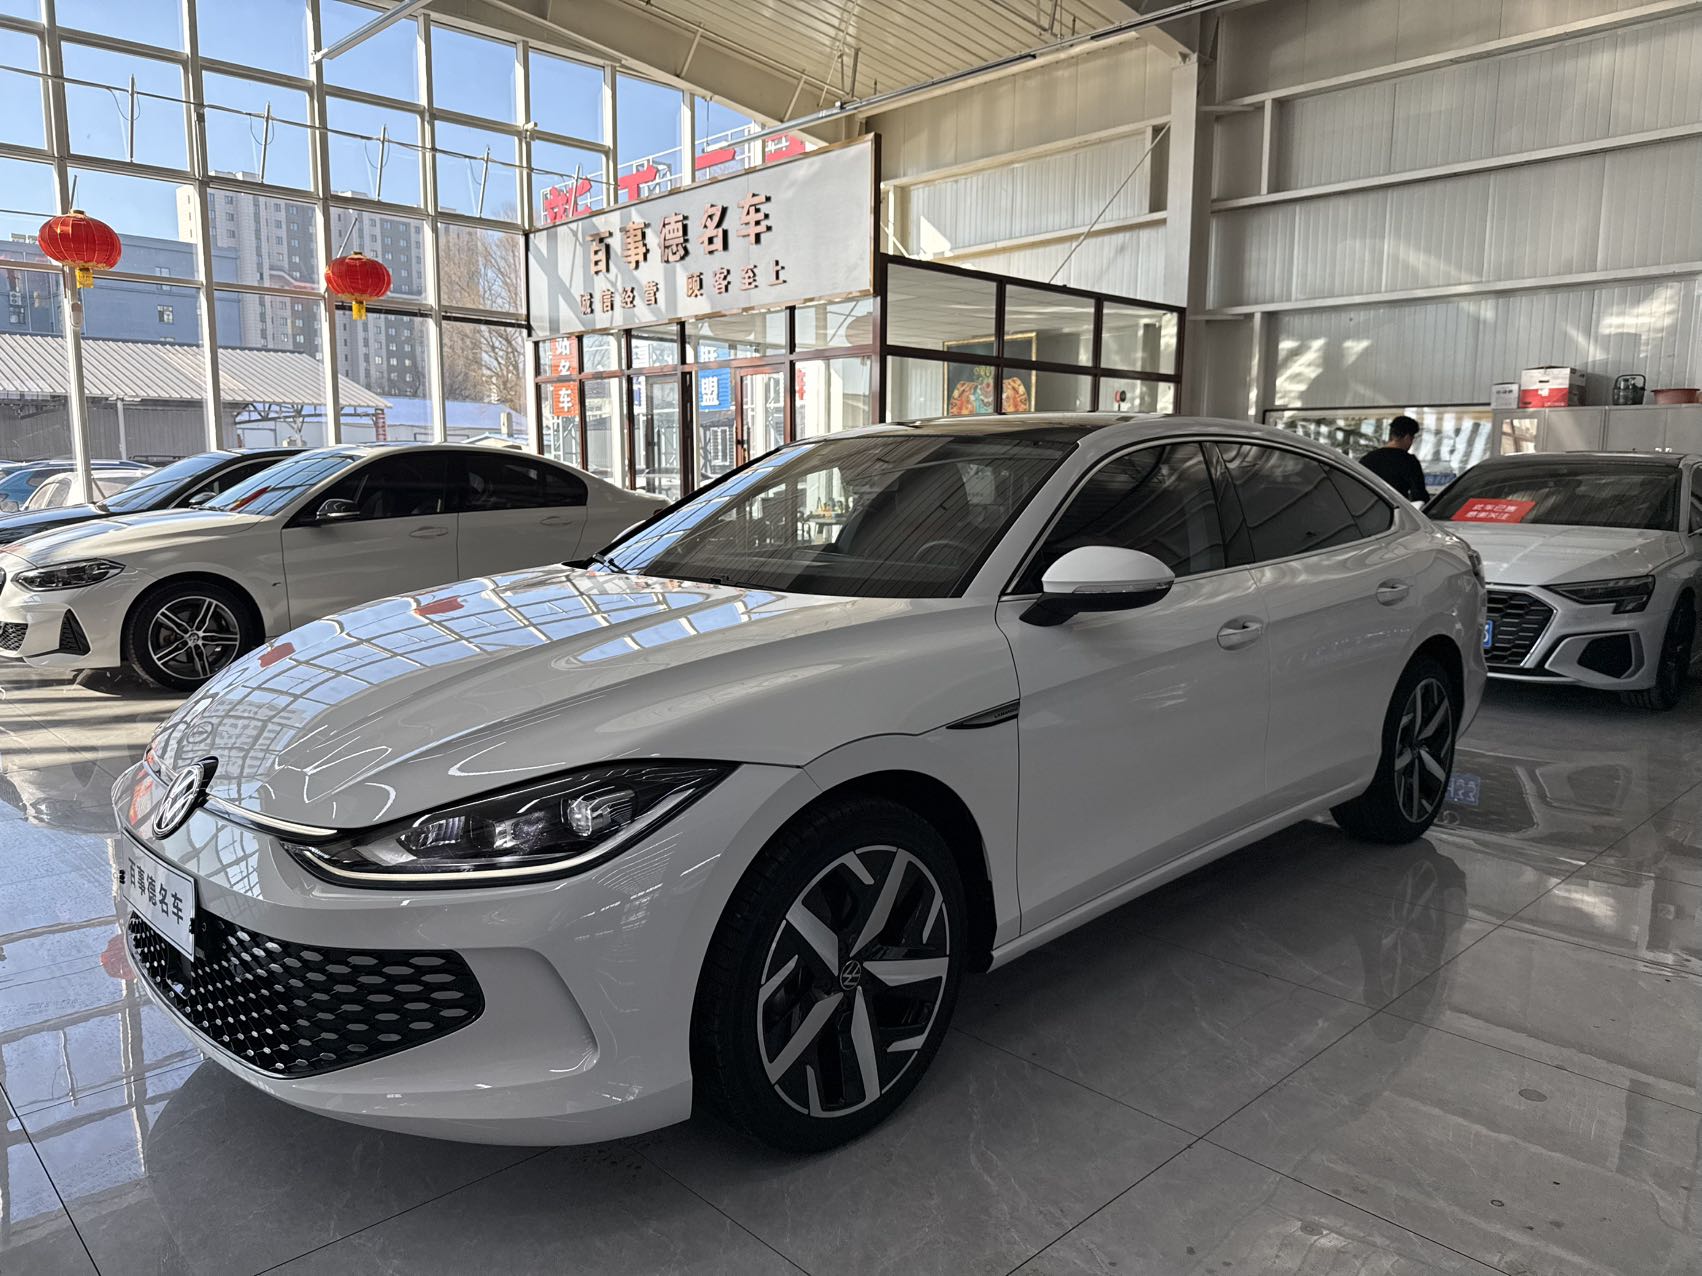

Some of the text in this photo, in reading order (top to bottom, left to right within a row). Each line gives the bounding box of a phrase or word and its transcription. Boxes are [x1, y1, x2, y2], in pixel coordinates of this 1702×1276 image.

[586, 192, 771, 276] 百事德名车
[580, 259, 787, 315] 诚信经营 顾客至上
[128, 857, 184, 925] 百事德名车
